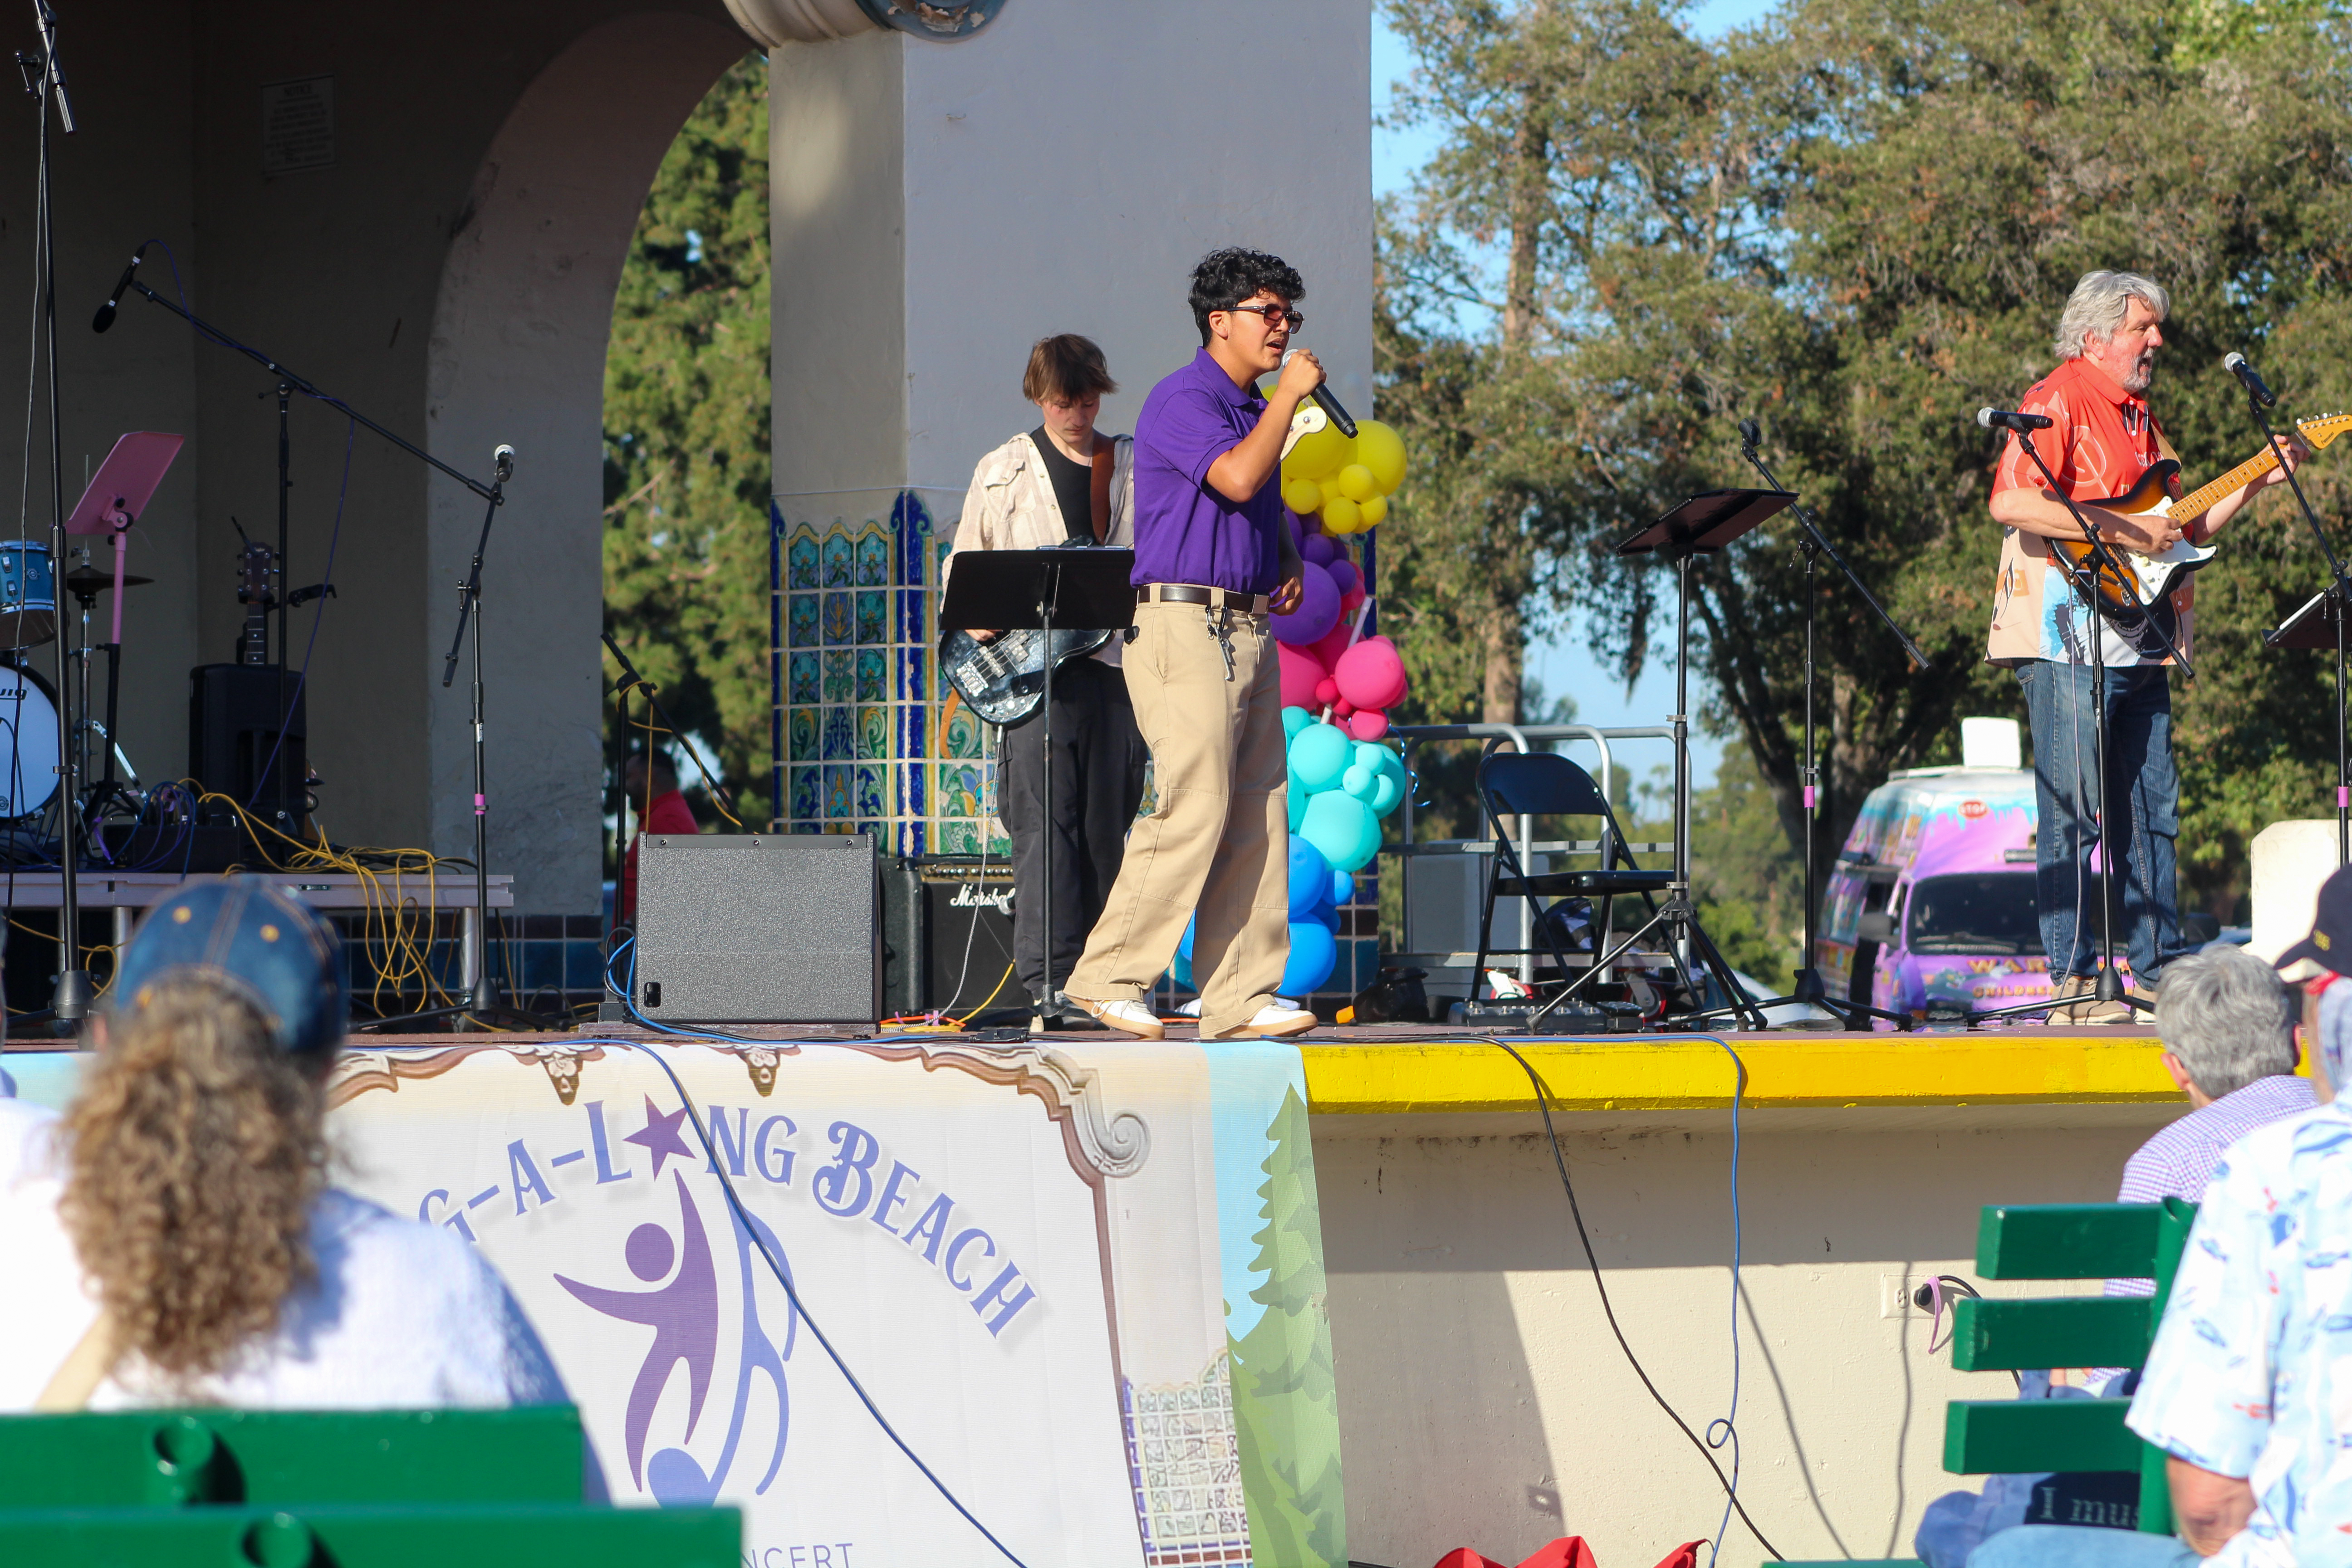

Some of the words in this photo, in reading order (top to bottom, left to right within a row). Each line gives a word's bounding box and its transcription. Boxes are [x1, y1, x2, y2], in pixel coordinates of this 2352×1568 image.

[1959, 802, 1987, 815] STOP
[950, 883, 1016, 907] Marshal
[812, 1121, 1037, 1338] BEACH
[2038, 1487, 2057, 1520] I
